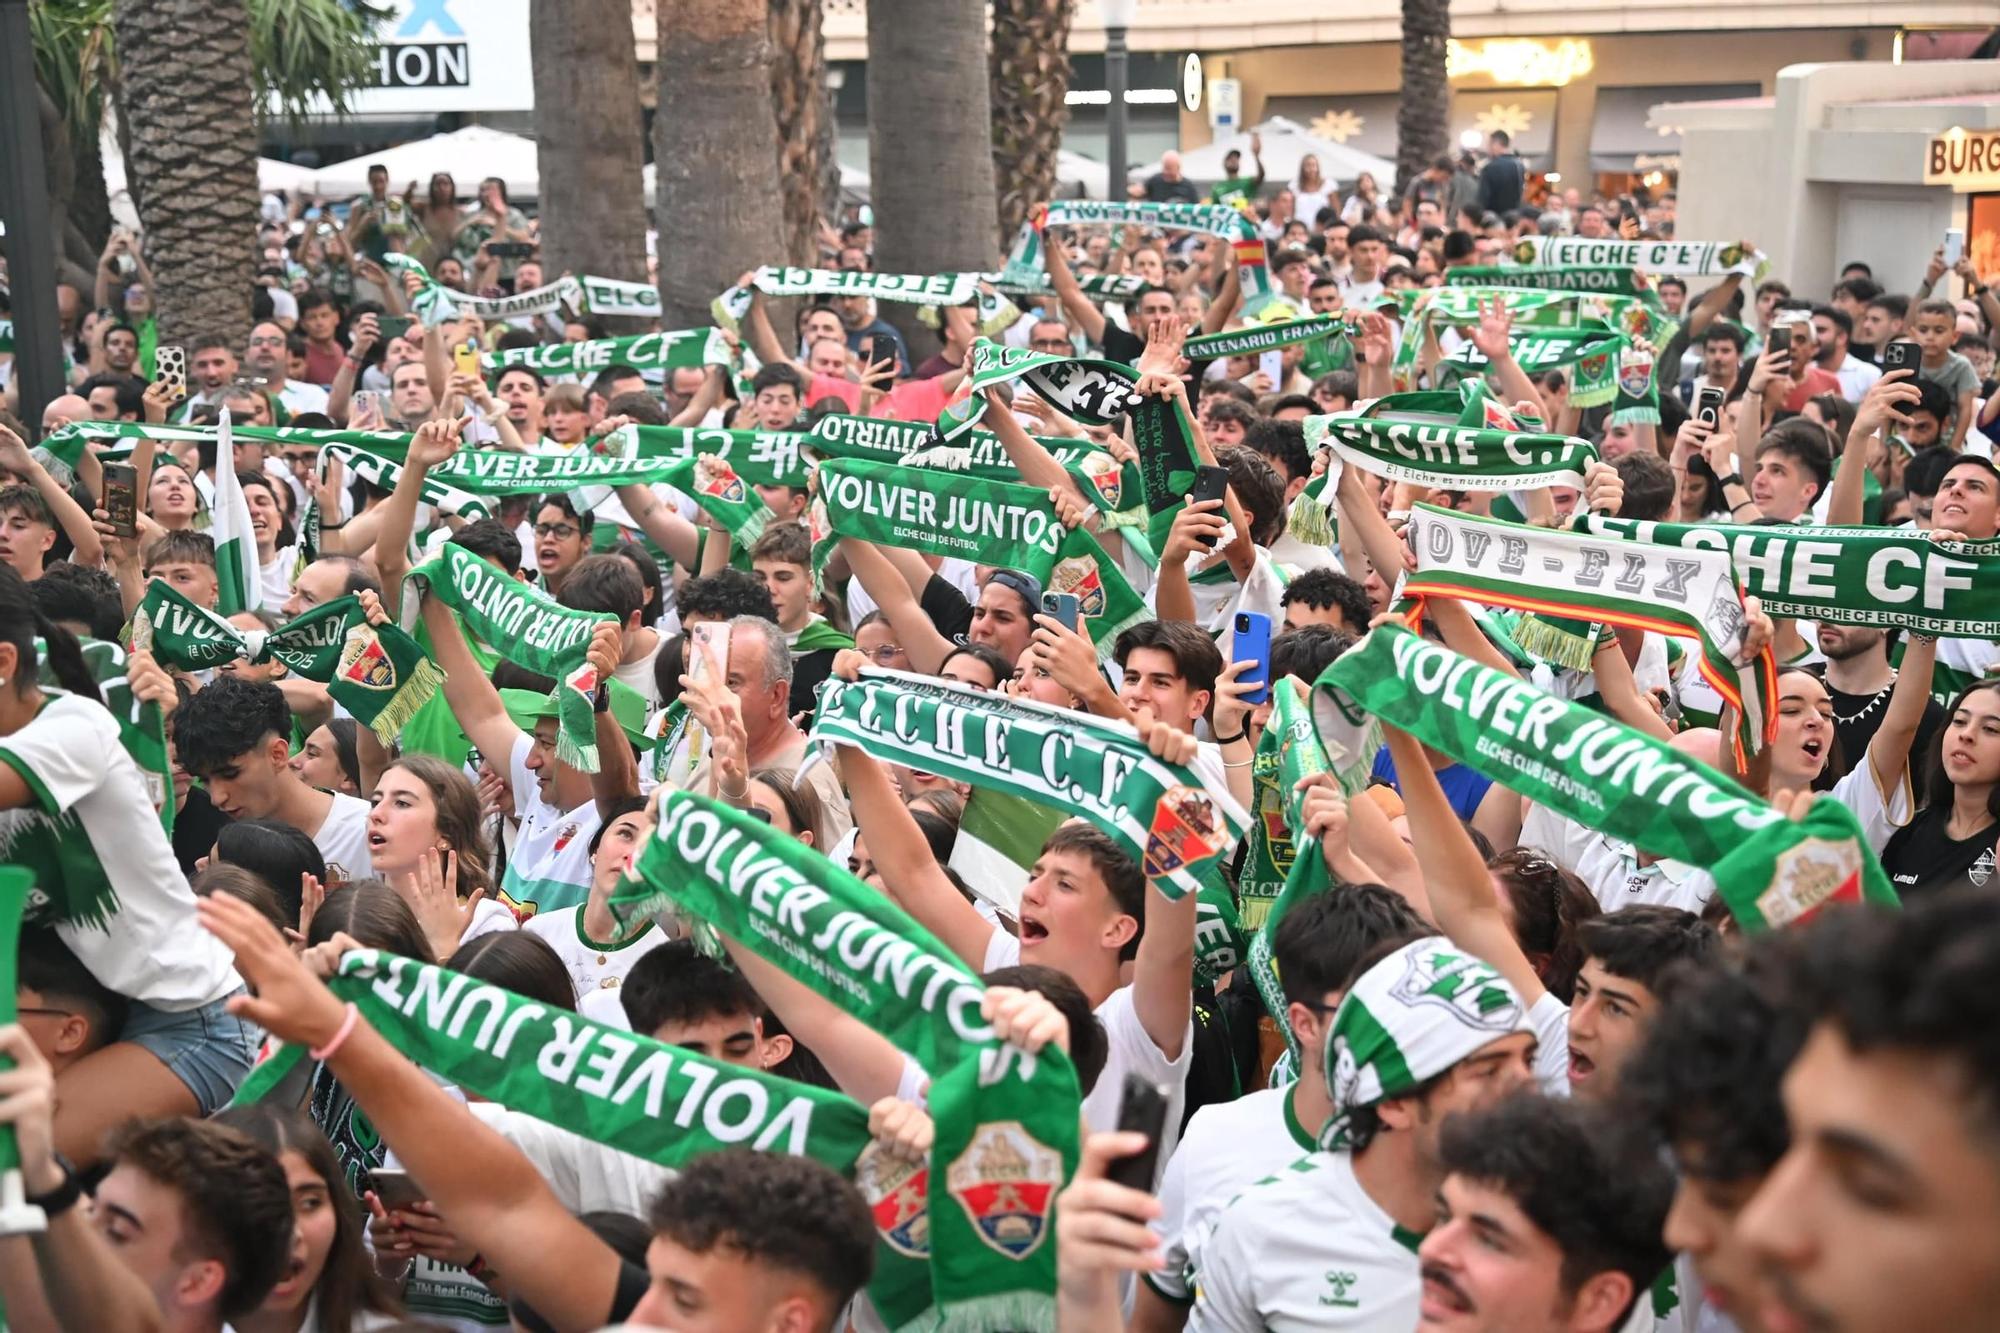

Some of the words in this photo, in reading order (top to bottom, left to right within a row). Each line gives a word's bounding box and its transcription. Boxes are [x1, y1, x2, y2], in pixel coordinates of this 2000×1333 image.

[1535, 269, 1619, 290] VOLVER
[1181, 332, 1277, 358] ENTENARIO
[1449, 338, 1573, 366] ELHE
[433, 451, 537, 478] OLVER
[1403, 467, 1437, 484] Elche
[1458, 476, 1508, 488] nuestra
[820, 469, 937, 527] VOLVER
[941, 496, 1067, 555] JUNTOS
[893, 525, 920, 541] ELCHE
[919, 529, 937, 544] CLUB
[938, 534, 949, 546] DE
[1891, 530, 1931, 540] ELCH
[1866, 546, 1979, 611] CF
[450, 551, 532, 637] JUNTOS
[1760, 599, 1780, 613] HE
[1781, 602, 1800, 615] CF
[1803, 606, 1851, 621] ELCHE
[1853, 610, 1873, 623] CF
[1876, 612, 1927, 630] ELCHE
[1928, 618, 1950, 632] CF
[276, 647, 318, 670] 2015
[819, 677, 1015, 774] ELCHE
[1391, 632, 1571, 751] VOLVER
[1553, 720, 1786, 831] JUNTOS
[1475, 735, 1516, 768] ELCHE
[1512, 753, 1542, 782] CLUB
[1540, 769, 1559, 789] DE
[655, 797, 830, 937] VOLVER
[812, 911, 1037, 1087] JUNTOS
[535, 1014, 815, 1157] VOLVER
[433, 1283, 458, 1297] Real
[482, 1293, 504, 1308] Gro
